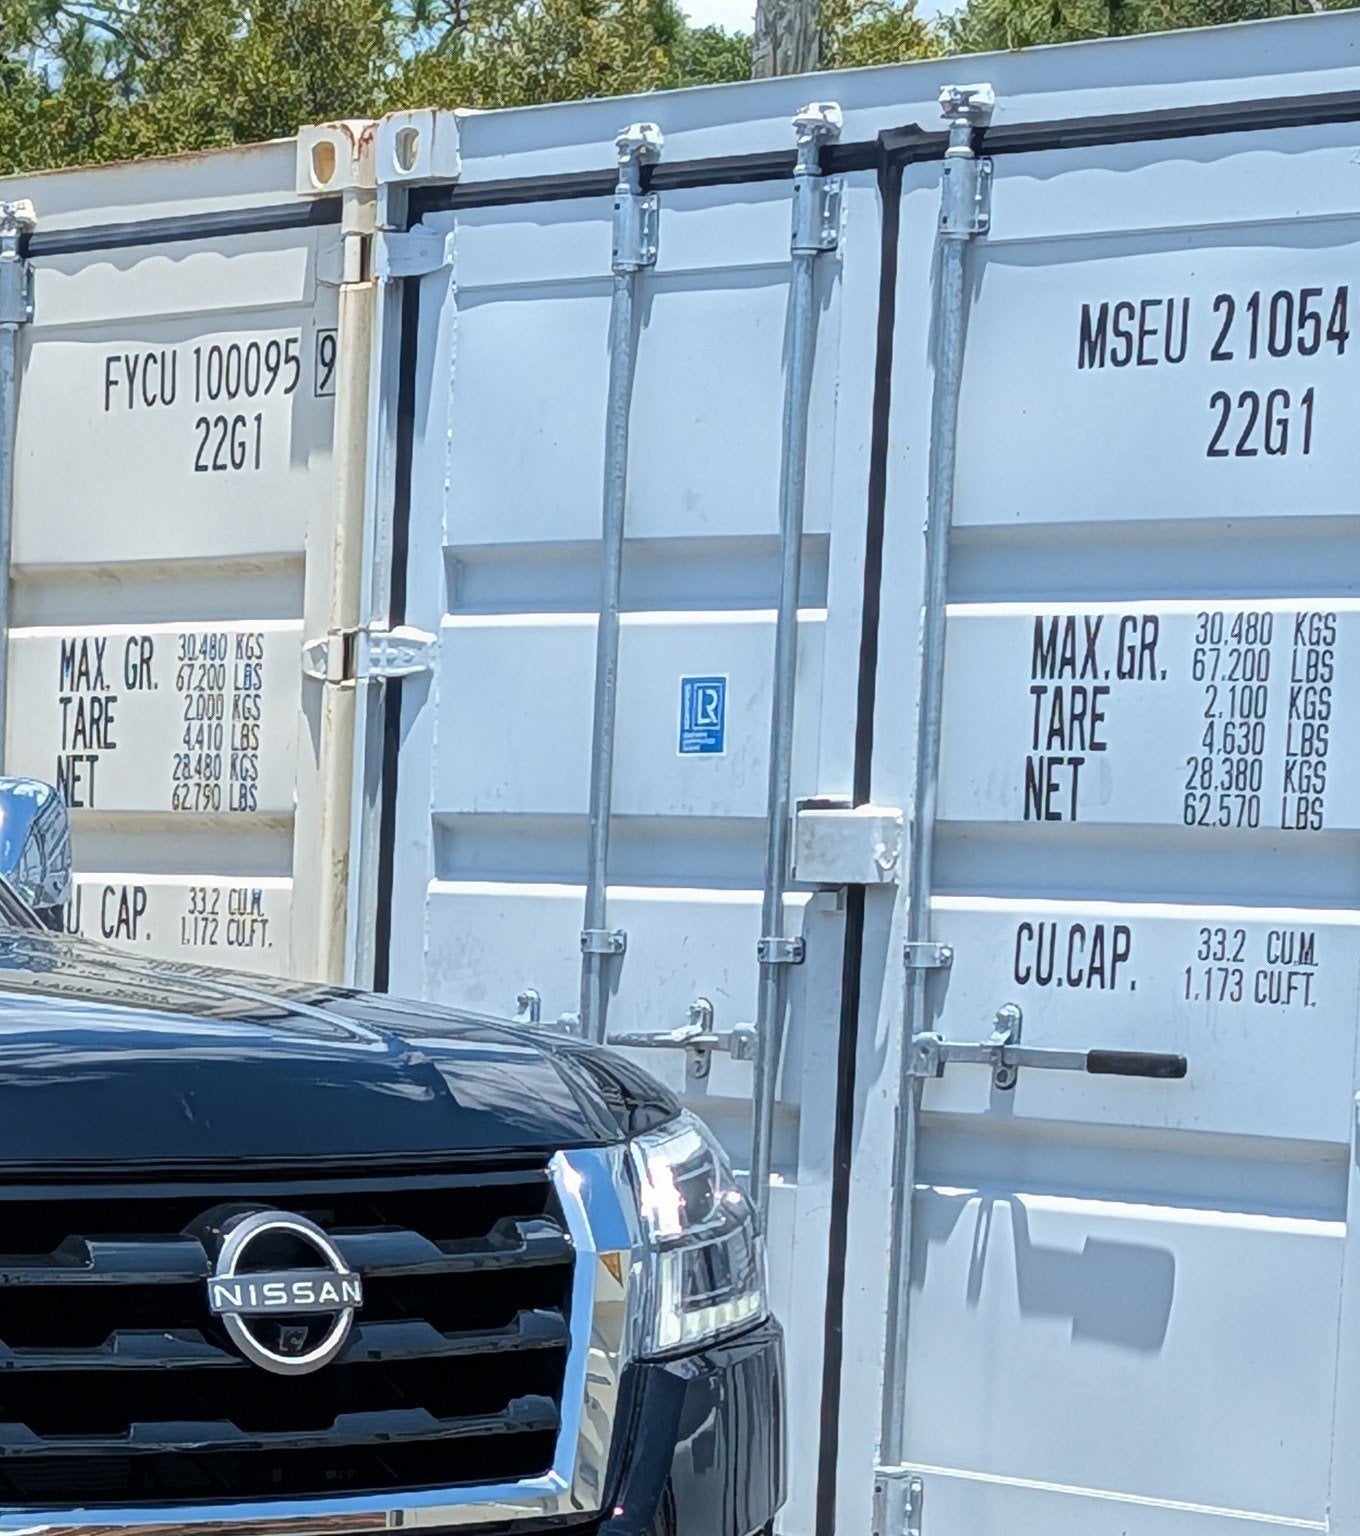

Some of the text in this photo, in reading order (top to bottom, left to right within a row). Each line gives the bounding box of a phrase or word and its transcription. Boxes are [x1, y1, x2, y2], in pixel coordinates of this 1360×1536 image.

[1077, 285, 1351, 369] MSEU 21054
[104, 334, 337, 412] FYCU 100095 9
[1206, 386, 1316, 458] 22G1
[193, 412, 264, 472] 22G1
[177, 632, 265, 661] 30.480 KGS
[1194, 611, 1337, 647] 30.480 KGS
[59, 635, 159, 692] MAX. GR.
[175, 662, 263, 692] 67.200 LBS
[1191, 647, 1335, 684] 67.200 LBS
[232, 693, 262, 722] KGS
[1029, 684, 1111, 751] TARE
[1203, 684, 1332, 721] 2.100 KGS
[58, 695, 118, 751] TARE
[230, 722, 260, 752] LBS
[1200, 720, 1330, 758] 4.630 LBS
[56, 754, 100, 809] NET
[229, 753, 259, 782] KGS
[1184, 756, 1327, 795] 28.380 KGS
[228, 783, 258, 812] LBS
[1023, 754, 1086, 822] NET
[1182, 792, 1324, 831] 62.570 LBS
[100, 884, 152, 941] CAP.
[1197, 926, 1247, 963] 33.2
[1183, 965, 1244, 1003] 1.173
[212, 1280, 363, 1307] NISSAN
